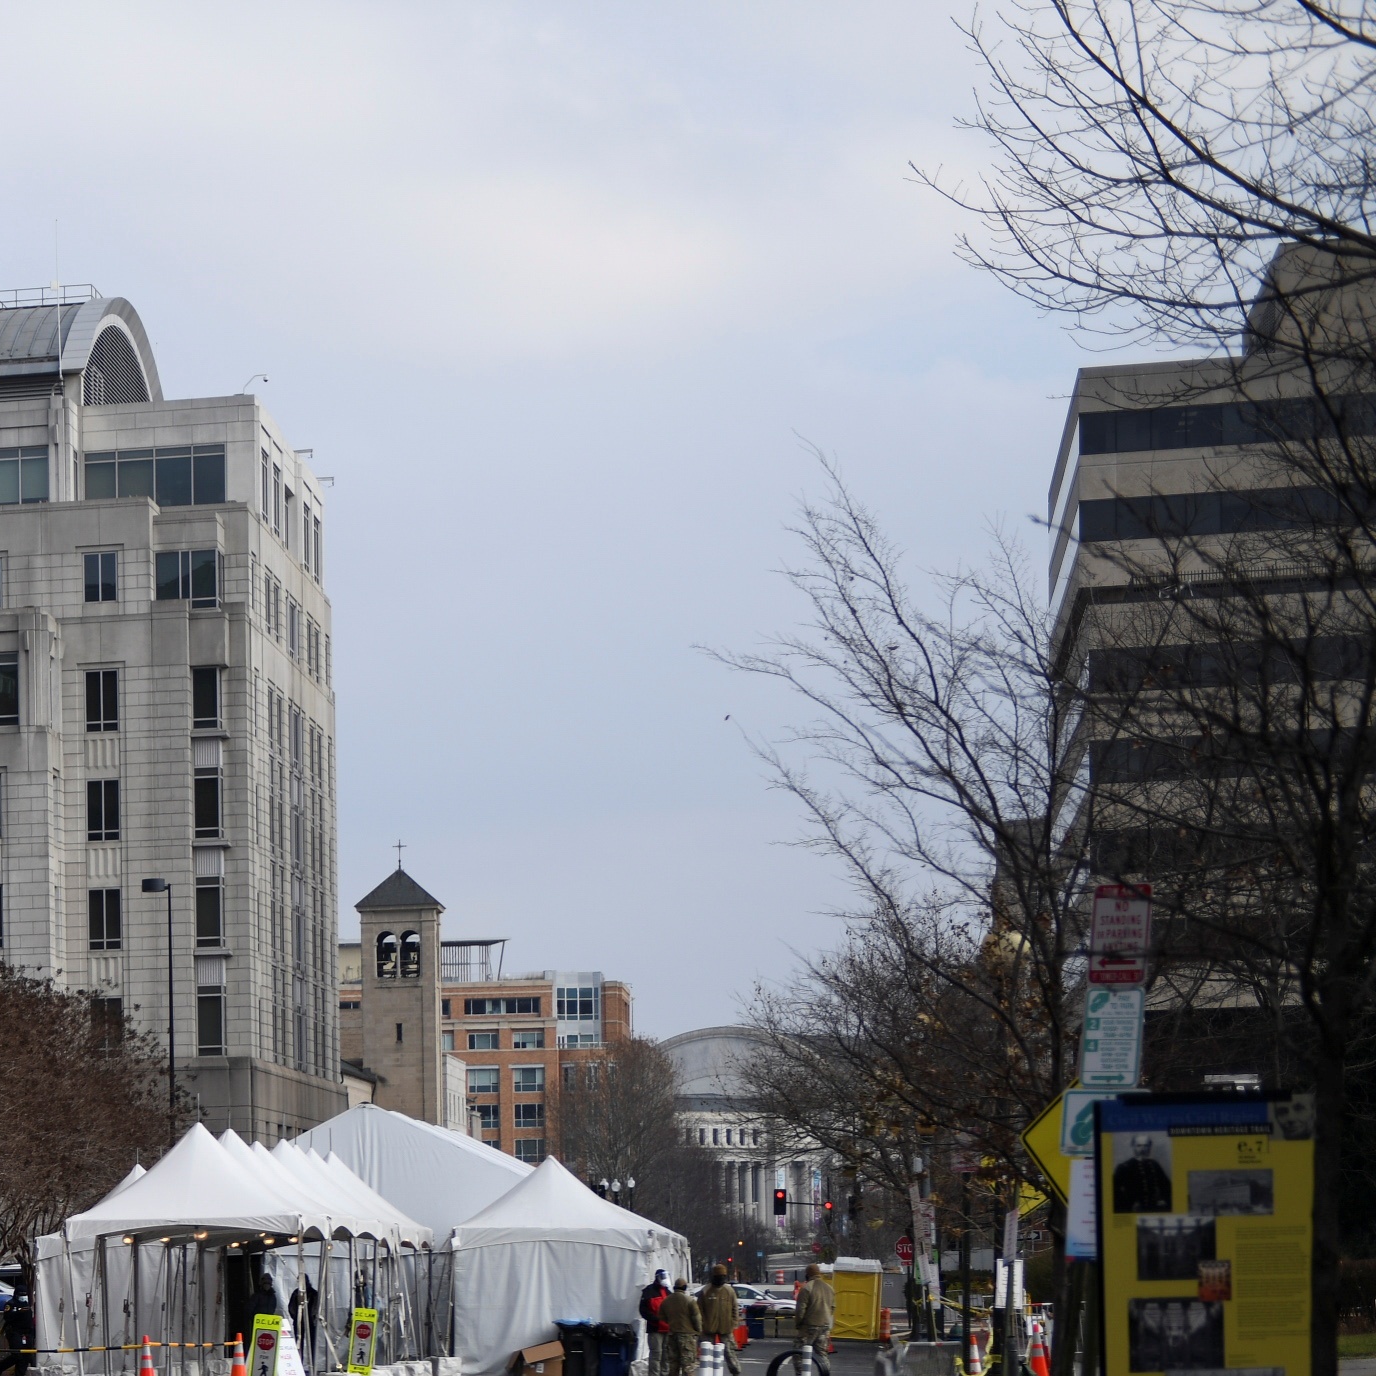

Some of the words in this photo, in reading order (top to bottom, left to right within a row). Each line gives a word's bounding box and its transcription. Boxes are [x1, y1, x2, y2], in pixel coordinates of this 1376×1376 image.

[1170, 1127, 1212, 1135] DOWNTOWN
[1214, 1126, 1248, 1134] HERITAGE
[1250, 1125, 1271, 1133] TRAIL
[897, 1243, 912, 1253] STO
